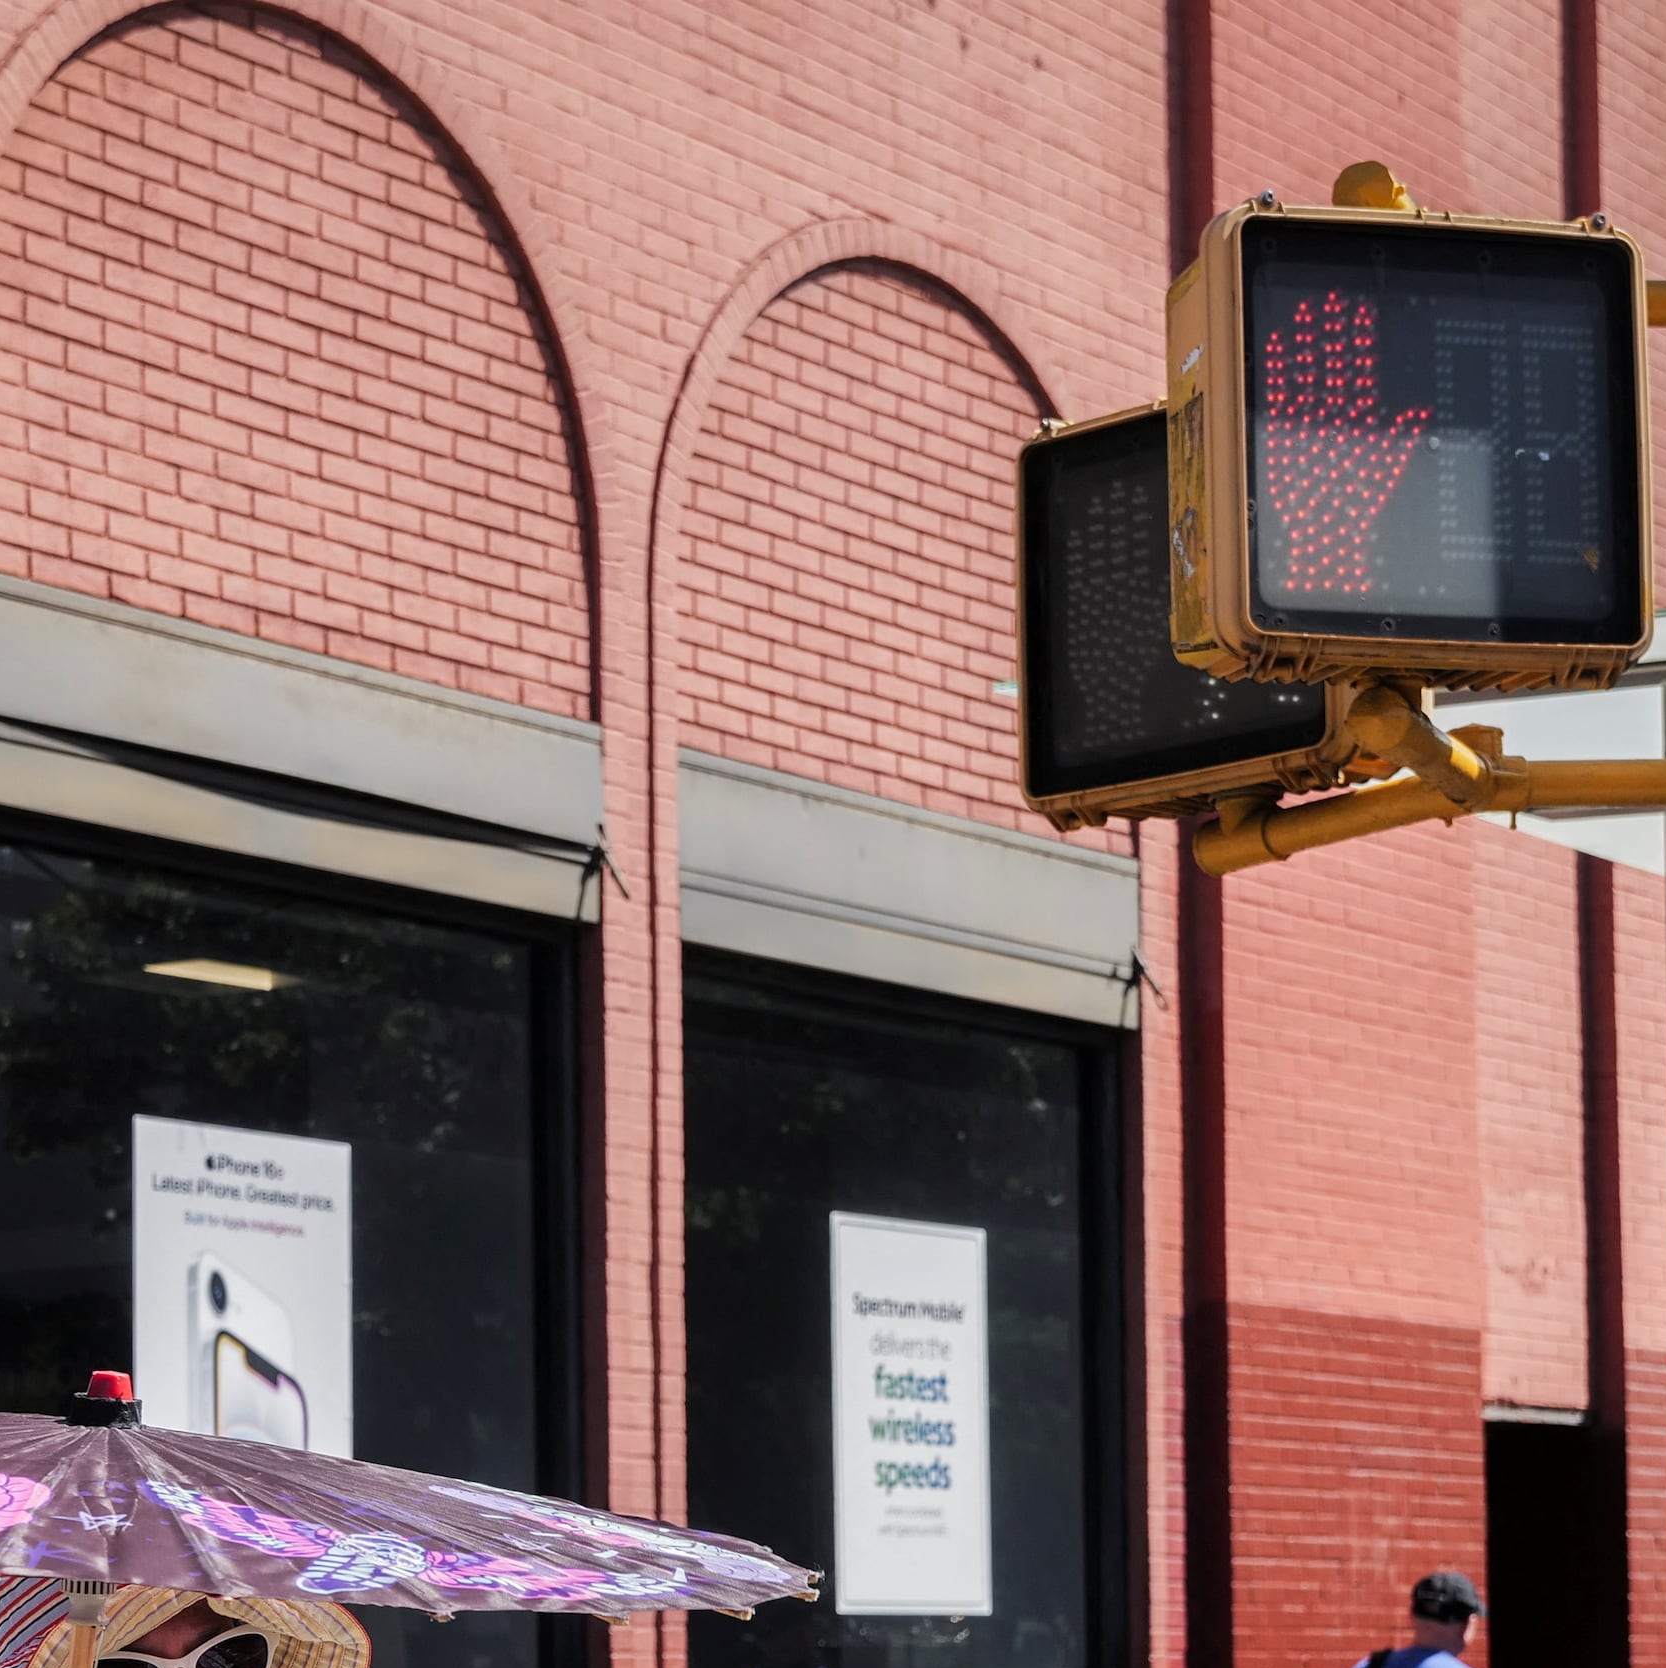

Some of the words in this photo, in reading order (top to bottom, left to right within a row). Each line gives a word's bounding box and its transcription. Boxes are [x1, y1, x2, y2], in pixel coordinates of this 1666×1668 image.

[218, 1155, 259, 1178] iPhone
[151, 1172, 194, 1194] Latest
[245, 1184, 298, 1207] Greatest
[852, 1292, 916, 1320] Spectrum
[869, 1332, 924, 1359] delivers
[926, 1337, 954, 1361] the
[873, 1362, 949, 1403] fastest
[868, 1407, 956, 1447] wireless
[873, 1455, 953, 1496] speeds
